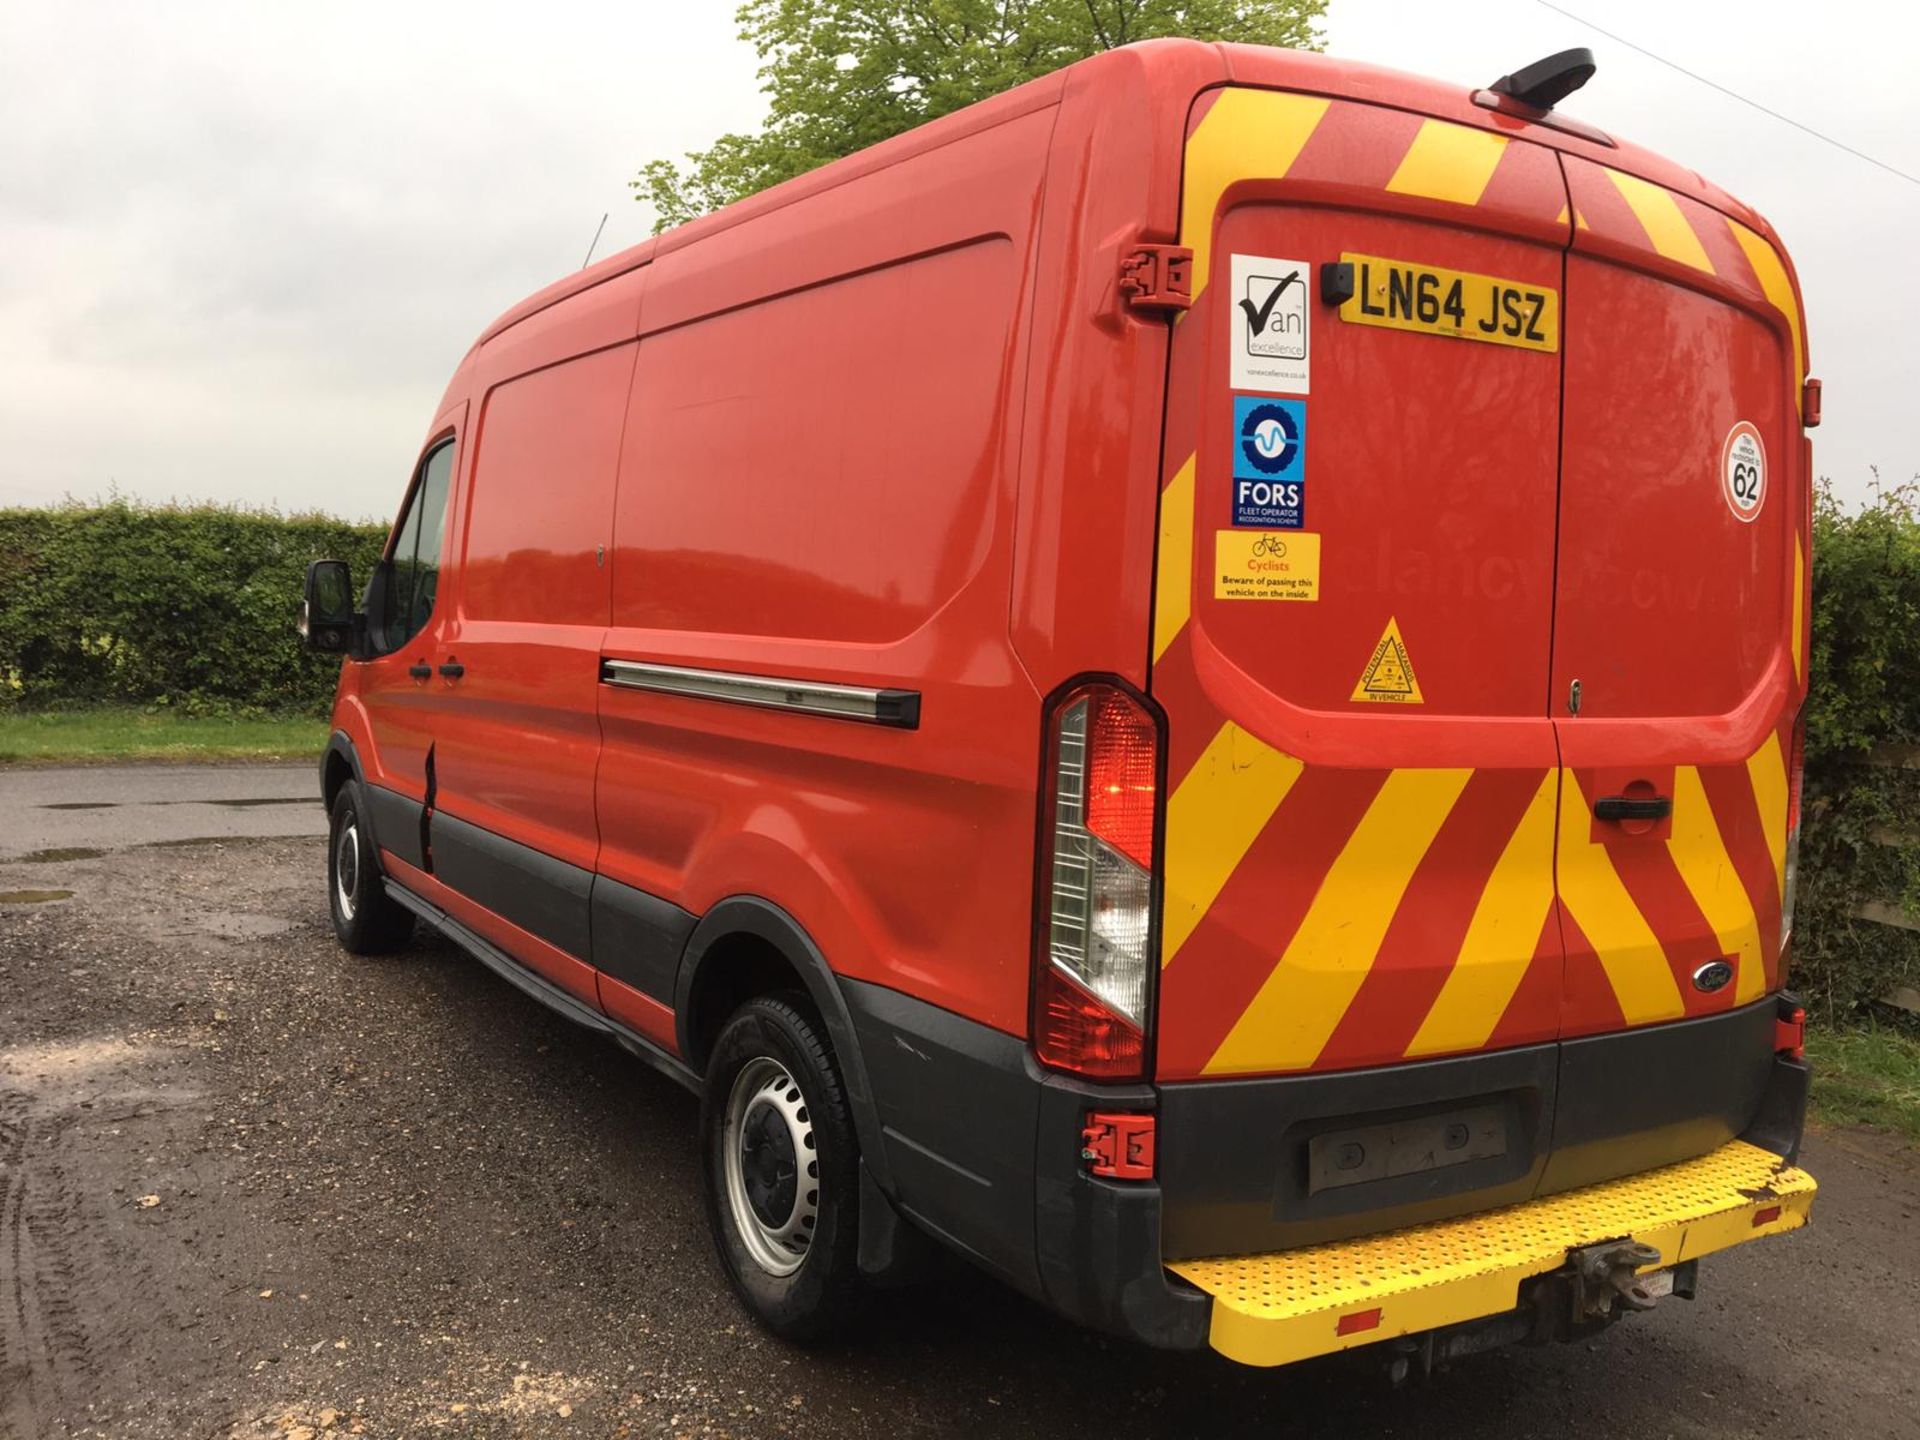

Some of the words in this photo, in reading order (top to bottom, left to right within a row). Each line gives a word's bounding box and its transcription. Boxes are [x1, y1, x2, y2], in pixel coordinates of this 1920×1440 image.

[1361, 263, 1465, 328] LN64
[1478, 285, 1546, 342] JSZ
[1250, 342, 1302, 355] excellence
[1734, 463, 1757, 500] 62
[1239, 481, 1300, 507] FORS
[1239, 507, 1260, 515] FLEET
[1261, 508, 1298, 517] OPERATOR
[1277, 517, 1298, 525] SCHEME
[1247, 559, 1290, 573] Cyclists
[1222, 575, 1254, 585] Beware
[1256, 576, 1266, 585] of
[1266, 578, 1296, 589] passing
[1298, 578, 1313, 588] this
[1226, 588, 1255, 597] vehicle
[1257, 590, 1269, 598] on
[1270, 589, 1284, 599] the
[1286, 590, 1309, 600] inside
[1379, 693, 1406, 702] VEHICLE
